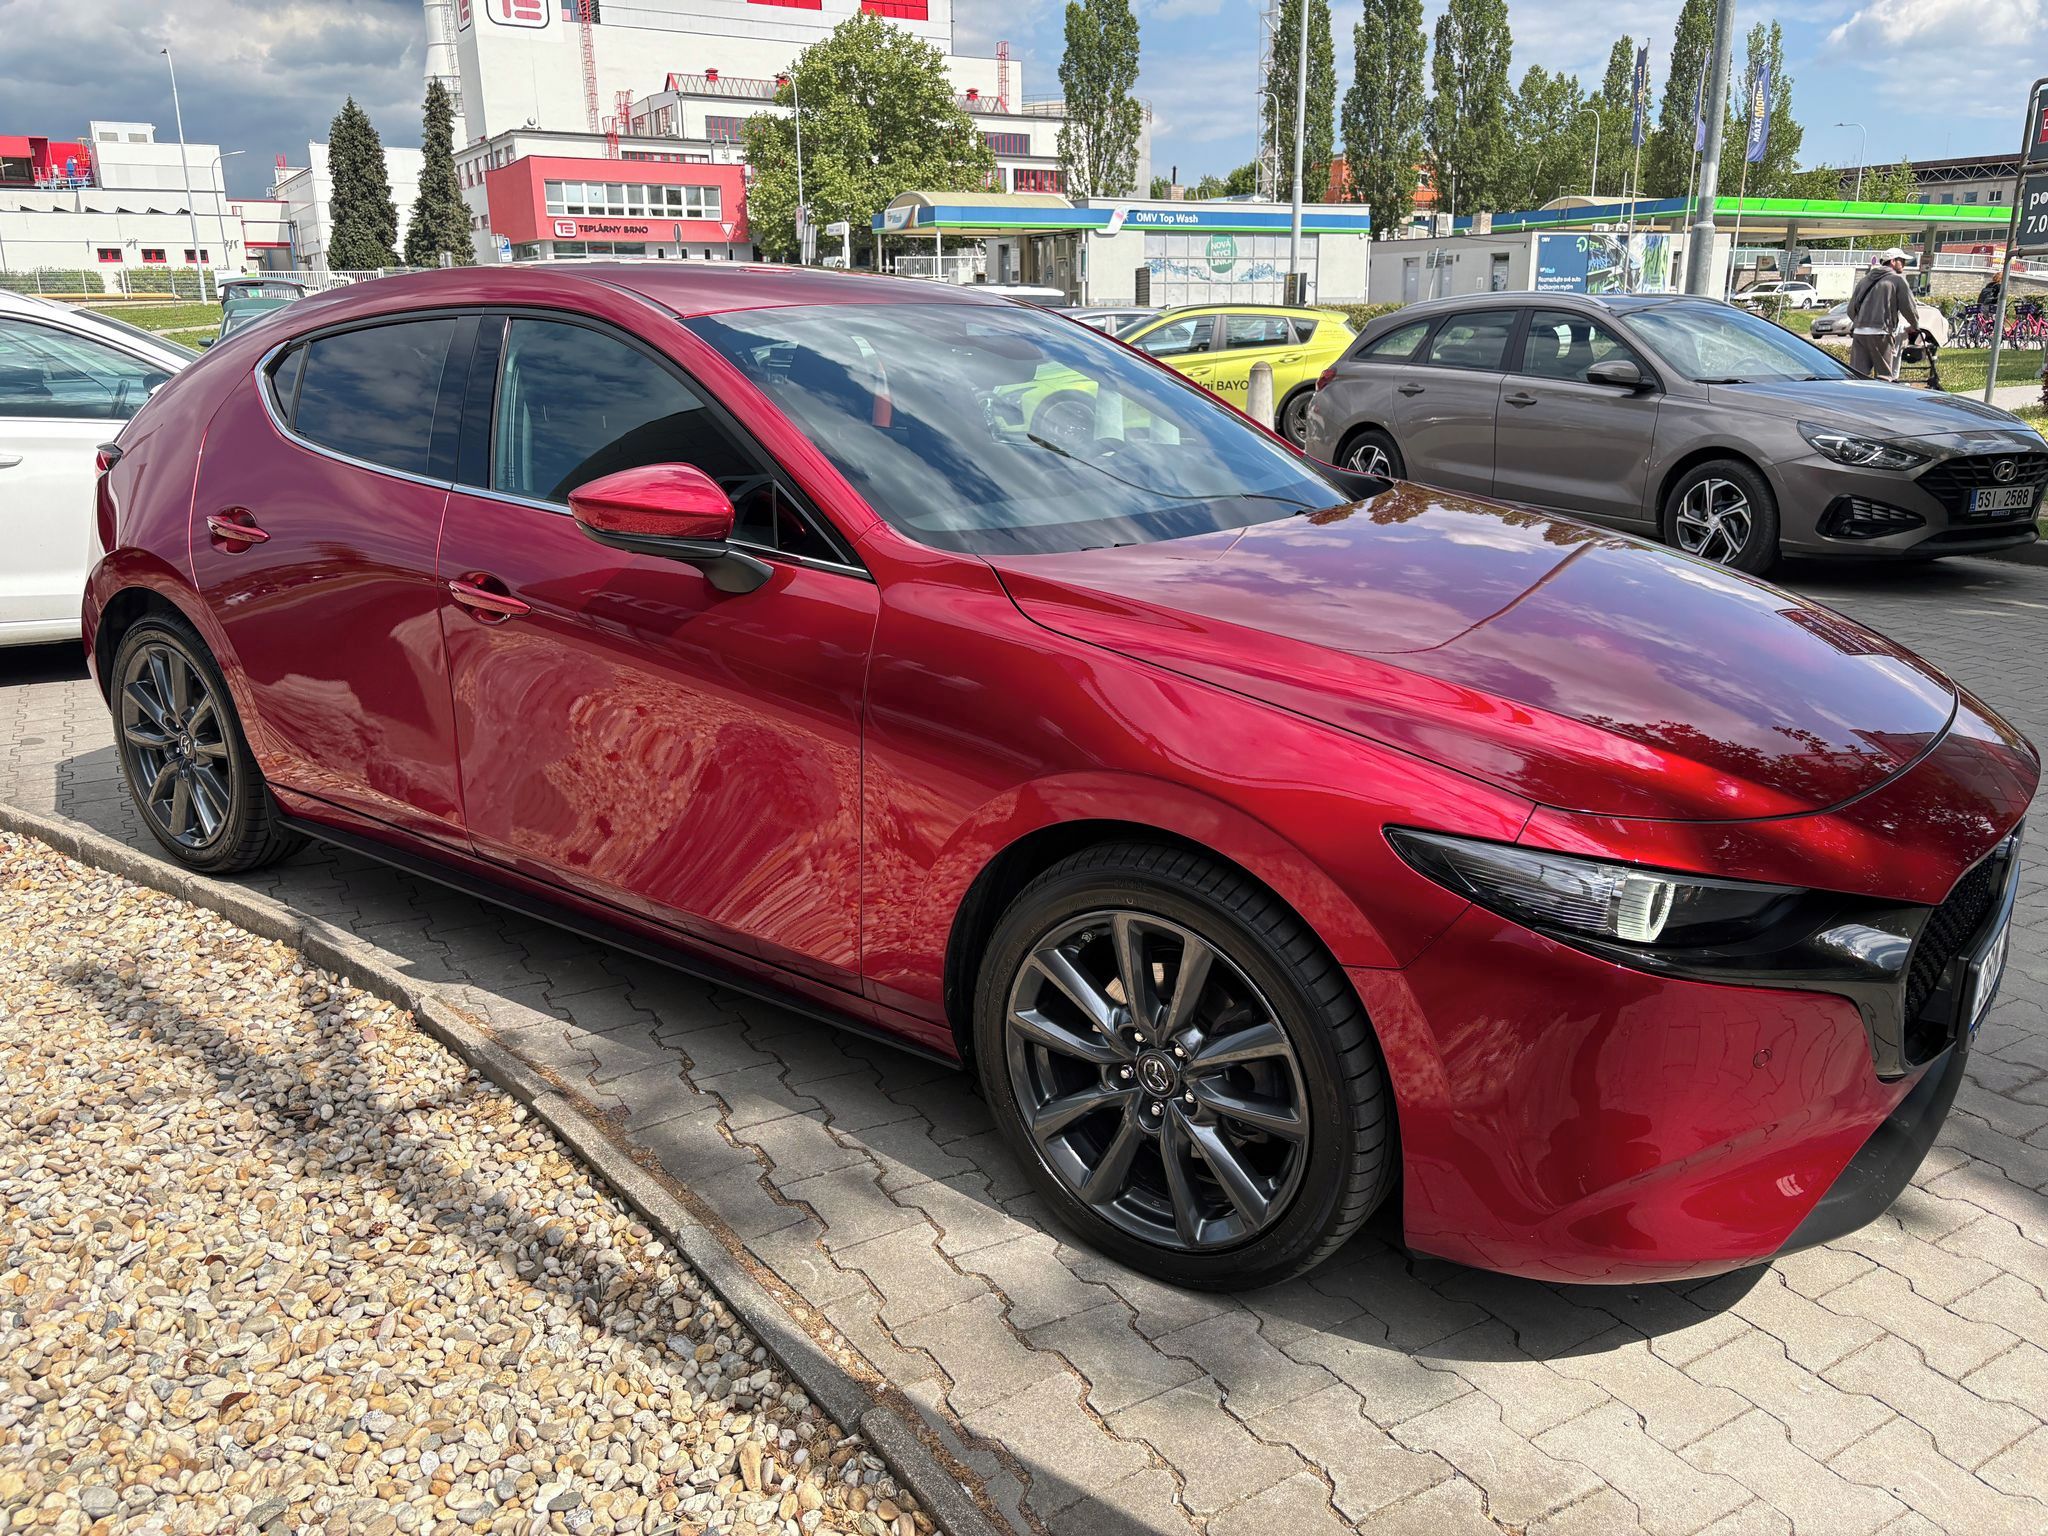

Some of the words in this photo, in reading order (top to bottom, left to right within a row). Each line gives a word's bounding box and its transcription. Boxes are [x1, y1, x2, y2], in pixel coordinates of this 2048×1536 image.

[1136, 212, 1157, 223] OMV
[1160, 213, 1175, 224] Top
[1176, 214, 1199, 223] Wash
[2026, 214, 2048, 234] 7.0
[578, 223, 622, 234] TEPLÁRNY
[623, 225, 649, 234] BRNO
[1217, 380, 1249, 391] BAYO
[1978, 490, 1997, 508] 5SI
[2004, 488, 2030, 507] 2588
